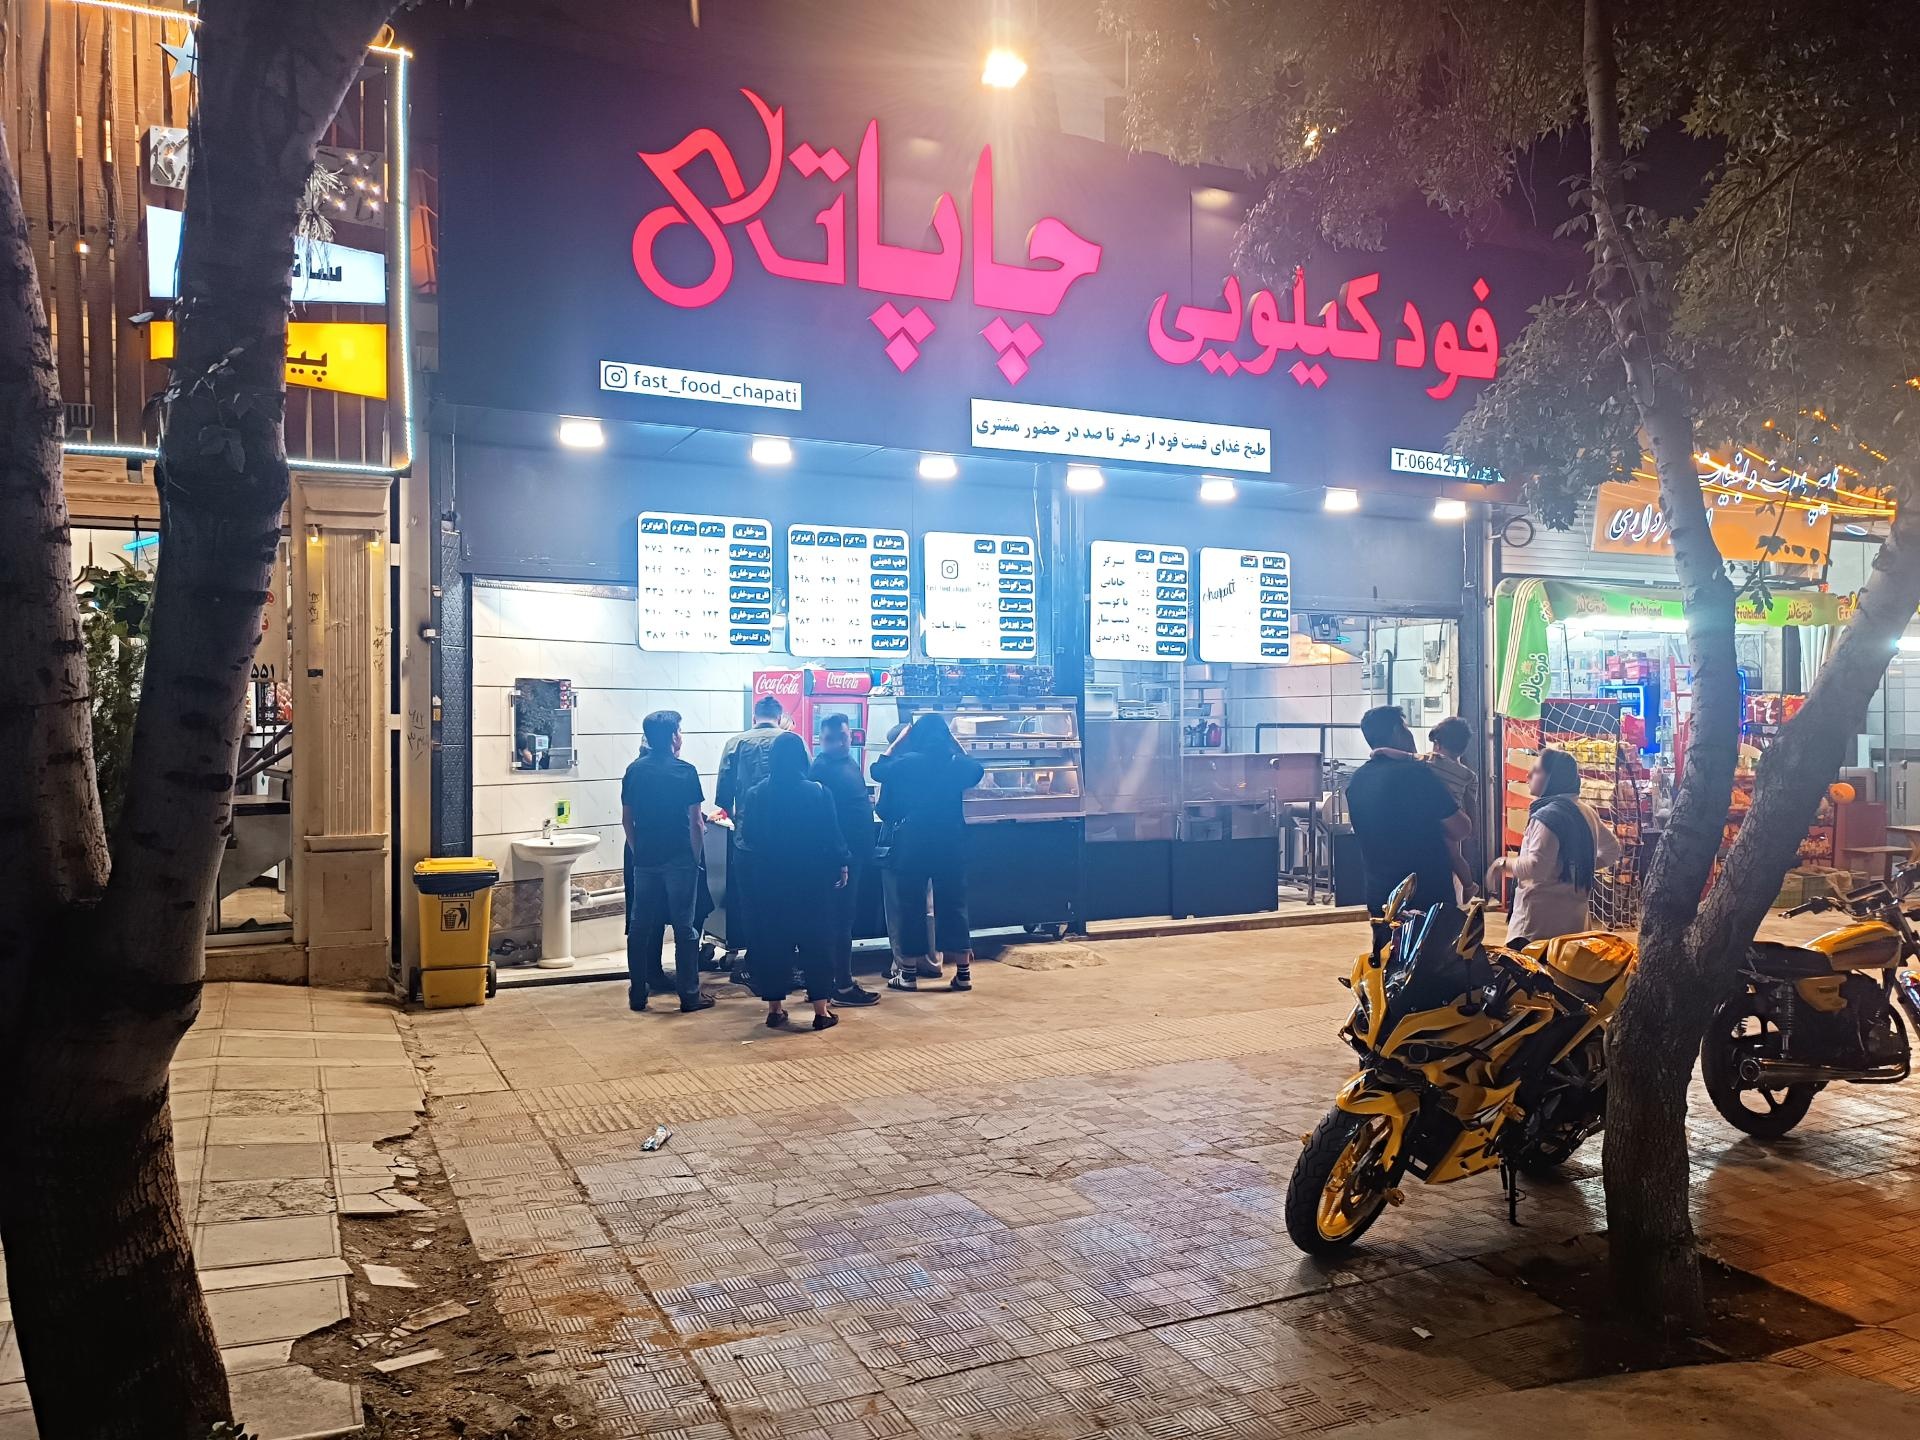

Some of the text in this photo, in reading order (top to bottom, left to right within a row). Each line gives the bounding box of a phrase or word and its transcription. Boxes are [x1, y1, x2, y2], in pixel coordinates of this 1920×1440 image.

[632, 88, 1499, 400] فود کیلویی چاپاتی
[634, 371, 797, 403] fast_food_chapati
[976, 416, 1266, 458] طبخ غذای فست فود از صفر تا صد در حضور مشتری
